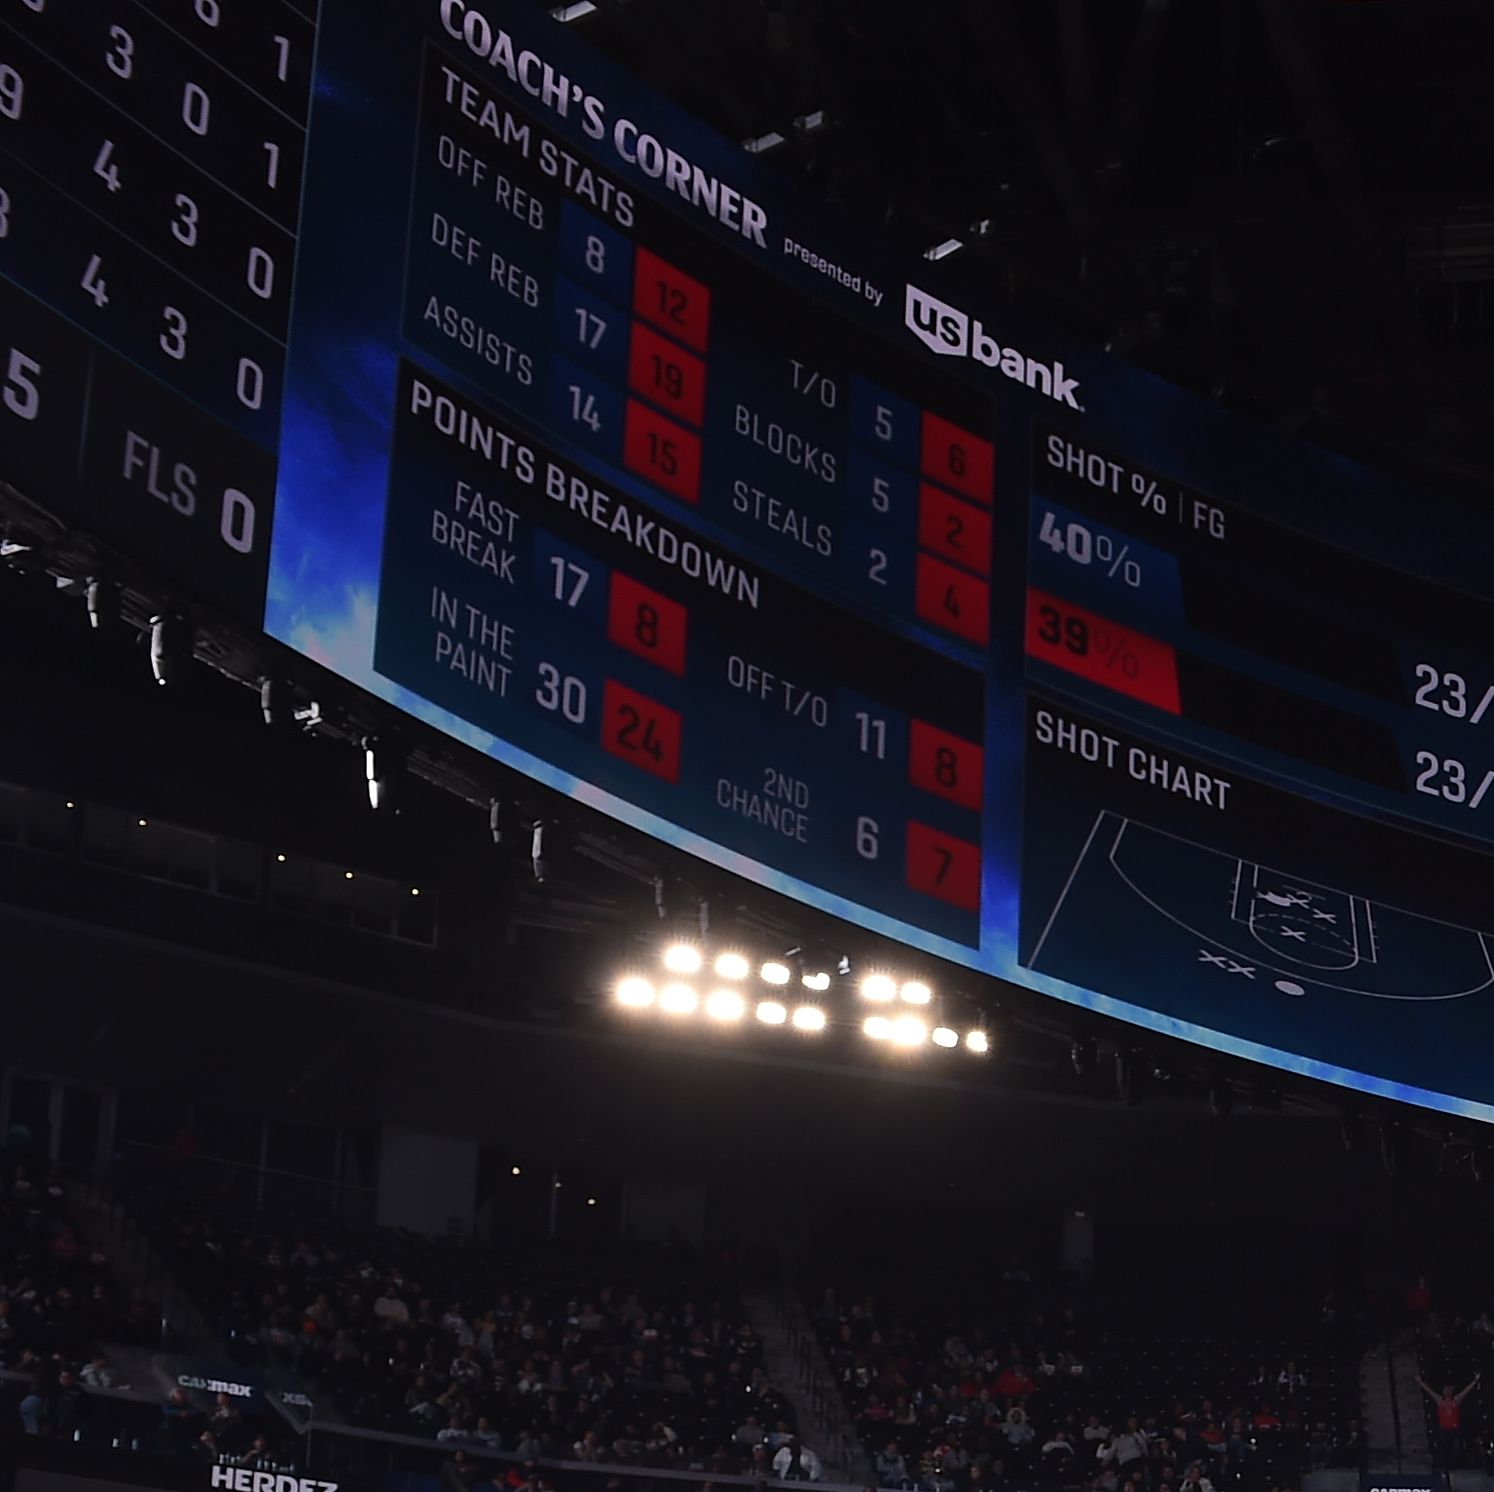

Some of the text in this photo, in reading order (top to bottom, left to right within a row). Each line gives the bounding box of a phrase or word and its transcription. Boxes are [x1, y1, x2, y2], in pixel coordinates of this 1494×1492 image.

[105, 25, 278, 189] 3 0 1
[439, 0, 769, 250] COACH'S CORNER
[441, 65, 636, 230] TEAM STATS
[438, 134, 545, 233] OFF REB
[94, 139, 121, 193] 4
[171, 193, 198, 247] 3
[246, 247, 274, 299] 0
[431, 212, 540, 308] DEF REB
[584, 234, 606, 274] 8
[783, 236, 883, 306] presented by
[81, 254, 263, 410] 4 3 0
[574, 305, 607, 350] 17
[654, 279, 689, 326] 12
[423, 295, 533, 387] ASSISTS
[3, 347, 42, 420] 5
[652, 353, 684, 398] 19
[569, 385, 601, 433] 14
[873, 406, 893, 442] 5
[647, 427, 679, 477] 15
[735, 404, 837, 483] BLOCKS
[946, 442, 968, 478] 6
[122, 430, 255, 554] FLS 0
[411, 379, 759, 608] POINTS BREAKDOWN
[454, 479, 520, 541] FAST
[732, 479, 833, 557] STEALS
[871, 478, 889, 513] 5
[1046, 436, 1226, 541] SHOT % FG
[431, 511, 517, 586] BREAK
[944, 513, 964, 549] 2
[1039, 513, 1142, 588] 40%
[549, 555, 590, 608] 17
[868, 549, 888, 584] 2
[430, 587, 515, 662] IN THE
[634, 601, 659, 650] 8
[941, 582, 961, 618] 4
[435, 630, 513, 697] PAINT
[536, 662, 588, 725] 30
[727, 654, 774, 703] OFF
[614, 702, 665, 763] 24
[855, 710, 887, 758] 11
[1036, 711, 1231, 810] SHOT CHART
[763, 767, 810, 810] 2ND
[933, 746, 958, 788] 8
[716, 778, 810, 843] CHANCE
[856, 817, 879, 860] 6
[934, 849, 954, 887] 7
